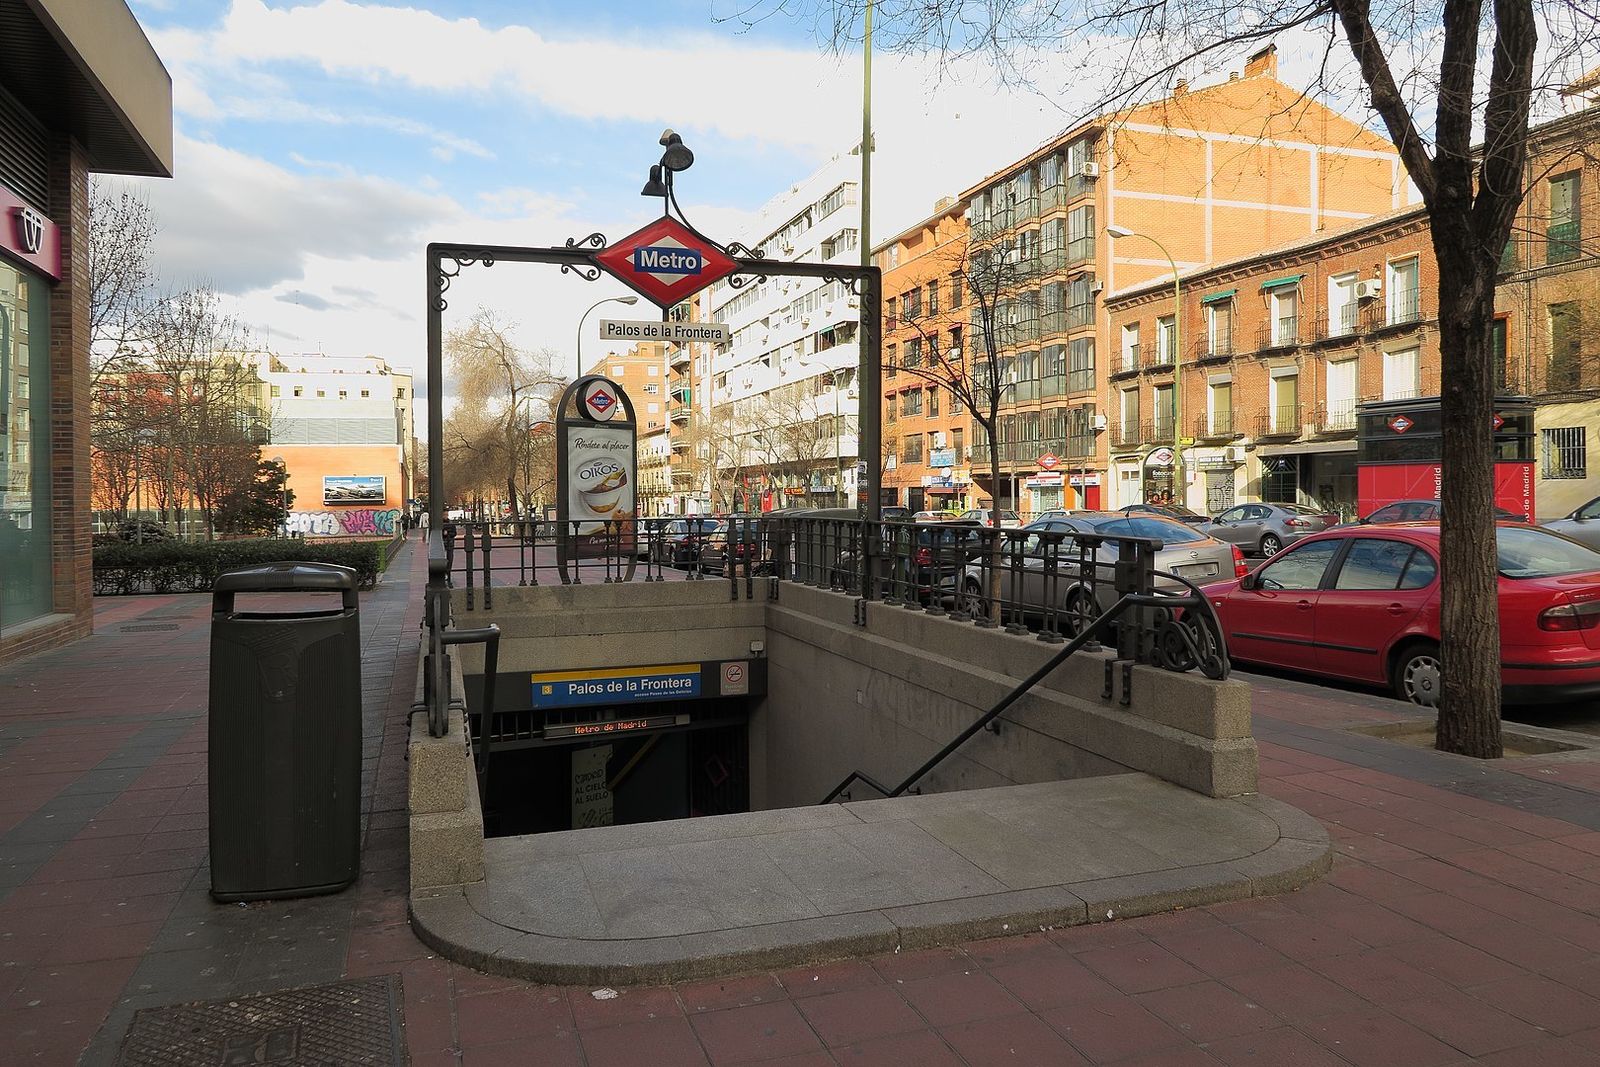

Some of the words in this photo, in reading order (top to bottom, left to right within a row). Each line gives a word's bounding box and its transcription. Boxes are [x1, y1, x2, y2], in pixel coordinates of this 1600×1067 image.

[640, 250, 697, 270] Metro
[607, 323, 640, 336] Palos
[643, 324, 657, 336] de
[661, 324, 671, 337] la
[675, 325, 722, 339] Frontera
[602, 440, 610, 449] al
[609, 441, 630, 451] placer
[580, 463, 619, 480] OIKOS
[1434, 467, 1442, 499] Madrid
[568, 682, 603, 695] Palos
[607, 681, 622, 693] de
[626, 679, 637, 691] la
[641, 677, 692, 690] Frontera
[575, 726, 600, 734] Metro
[618, 720, 647, 730] Madrid
[575, 786, 584, 795] AL
[575, 796, 584, 805] AL
[586, 791, 609, 802] SUELO
